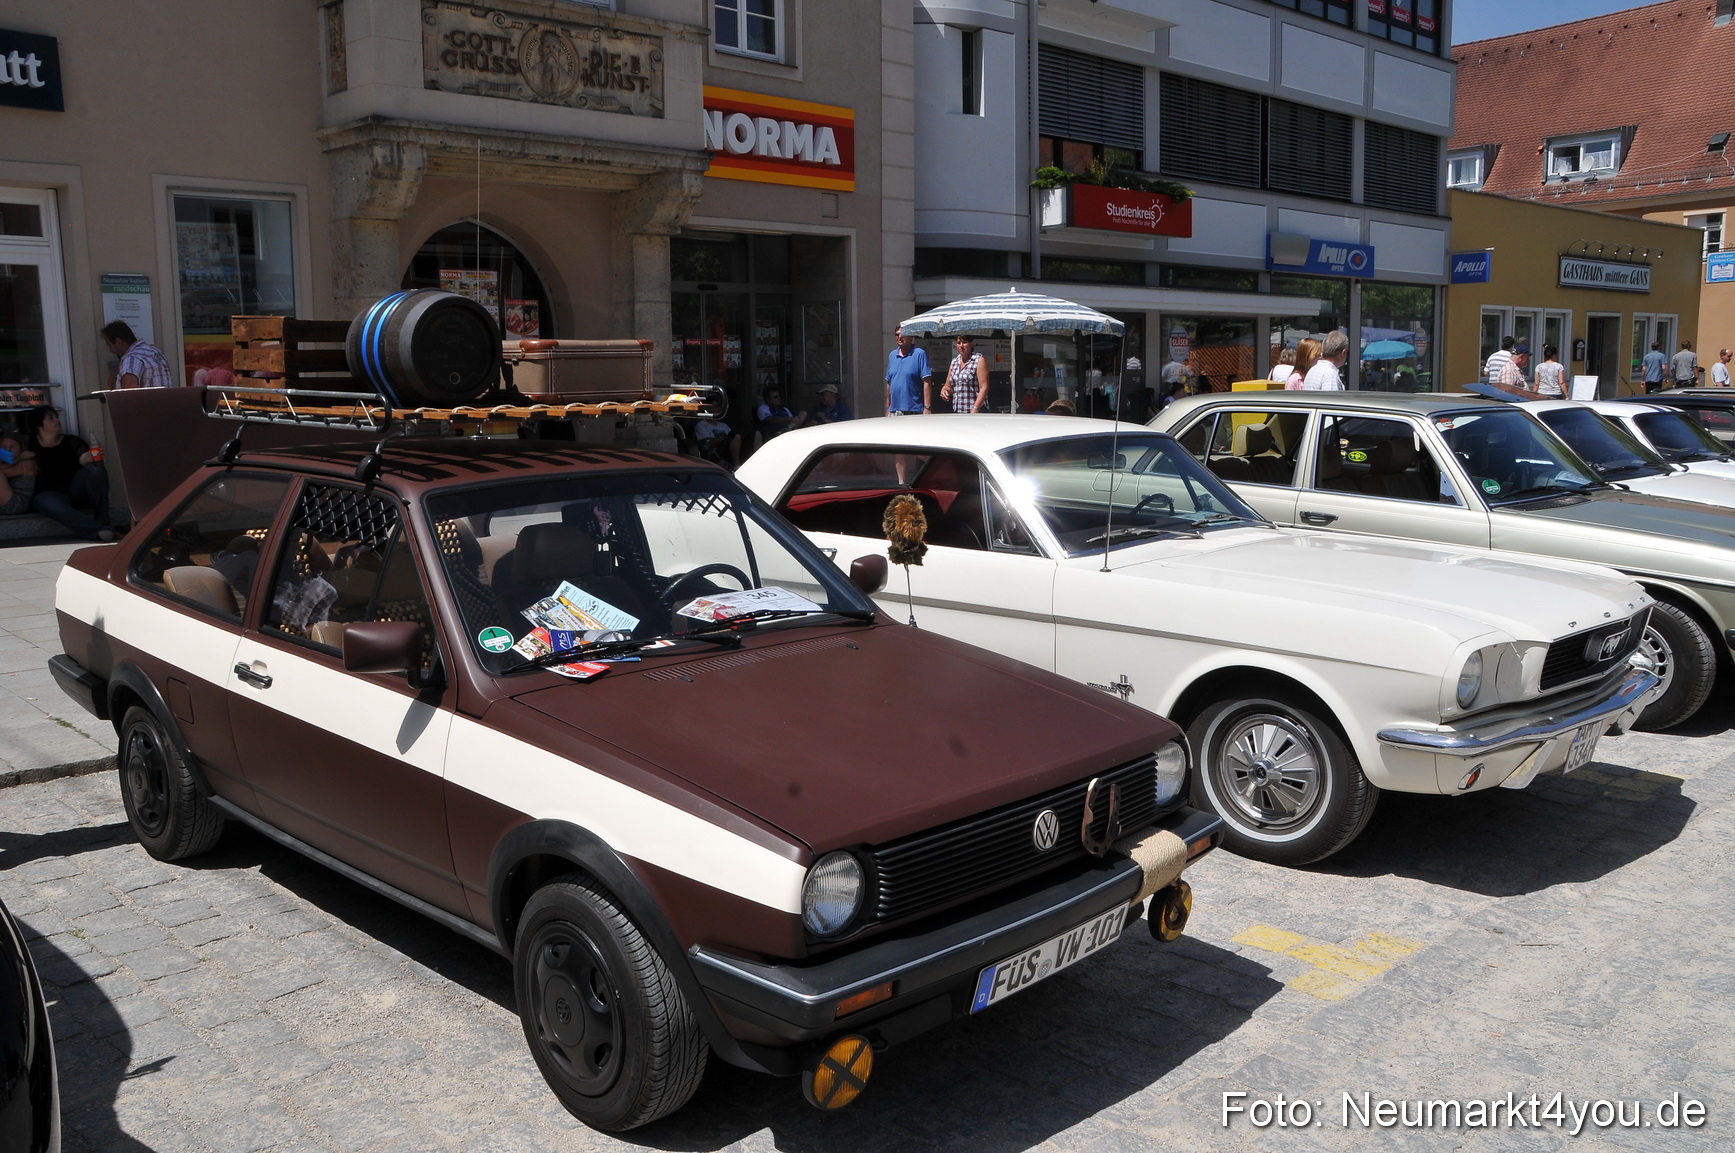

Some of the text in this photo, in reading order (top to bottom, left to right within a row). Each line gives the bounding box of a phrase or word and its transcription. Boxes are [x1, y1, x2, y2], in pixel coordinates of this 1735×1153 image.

[703, 109, 842, 165] NORMA
[1106, 202, 1156, 220] Studienkreis
[1453, 260, 1487, 273] APOLLO
[1563, 262, 1605, 282] GASTHAUS
[1629, 269, 1649, 286] GANS
[746, 590, 777, 600] 345
[488, 628, 497, 638] 1
[978, 906, 1126, 1004] D FÜS VW 101
